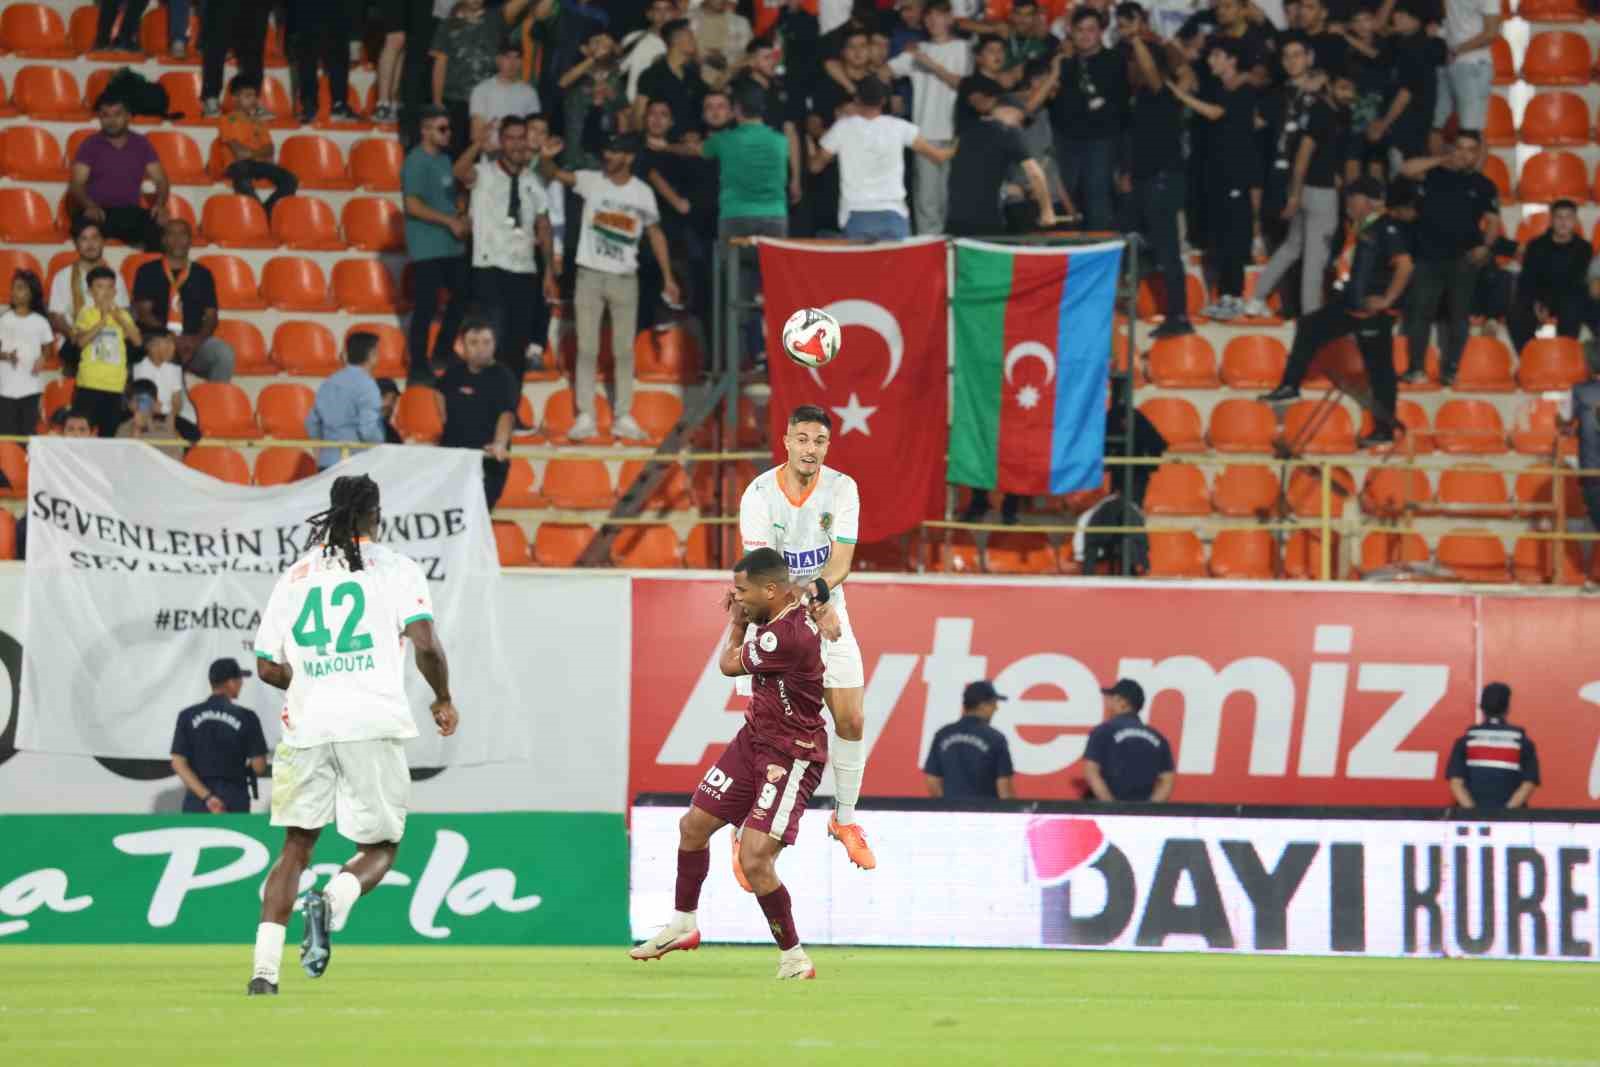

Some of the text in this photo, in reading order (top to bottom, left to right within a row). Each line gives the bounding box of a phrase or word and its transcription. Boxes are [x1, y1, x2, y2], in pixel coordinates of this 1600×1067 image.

[32, 490, 264, 558] SEVENLERİN
[784, 545, 829, 569] TAV
[291, 581, 374, 656] 42
[303, 655, 375, 677] MAKOUTA
[757, 782, 778, 810] 9
[1027, 818, 1600, 957] DAYI KÜRE
